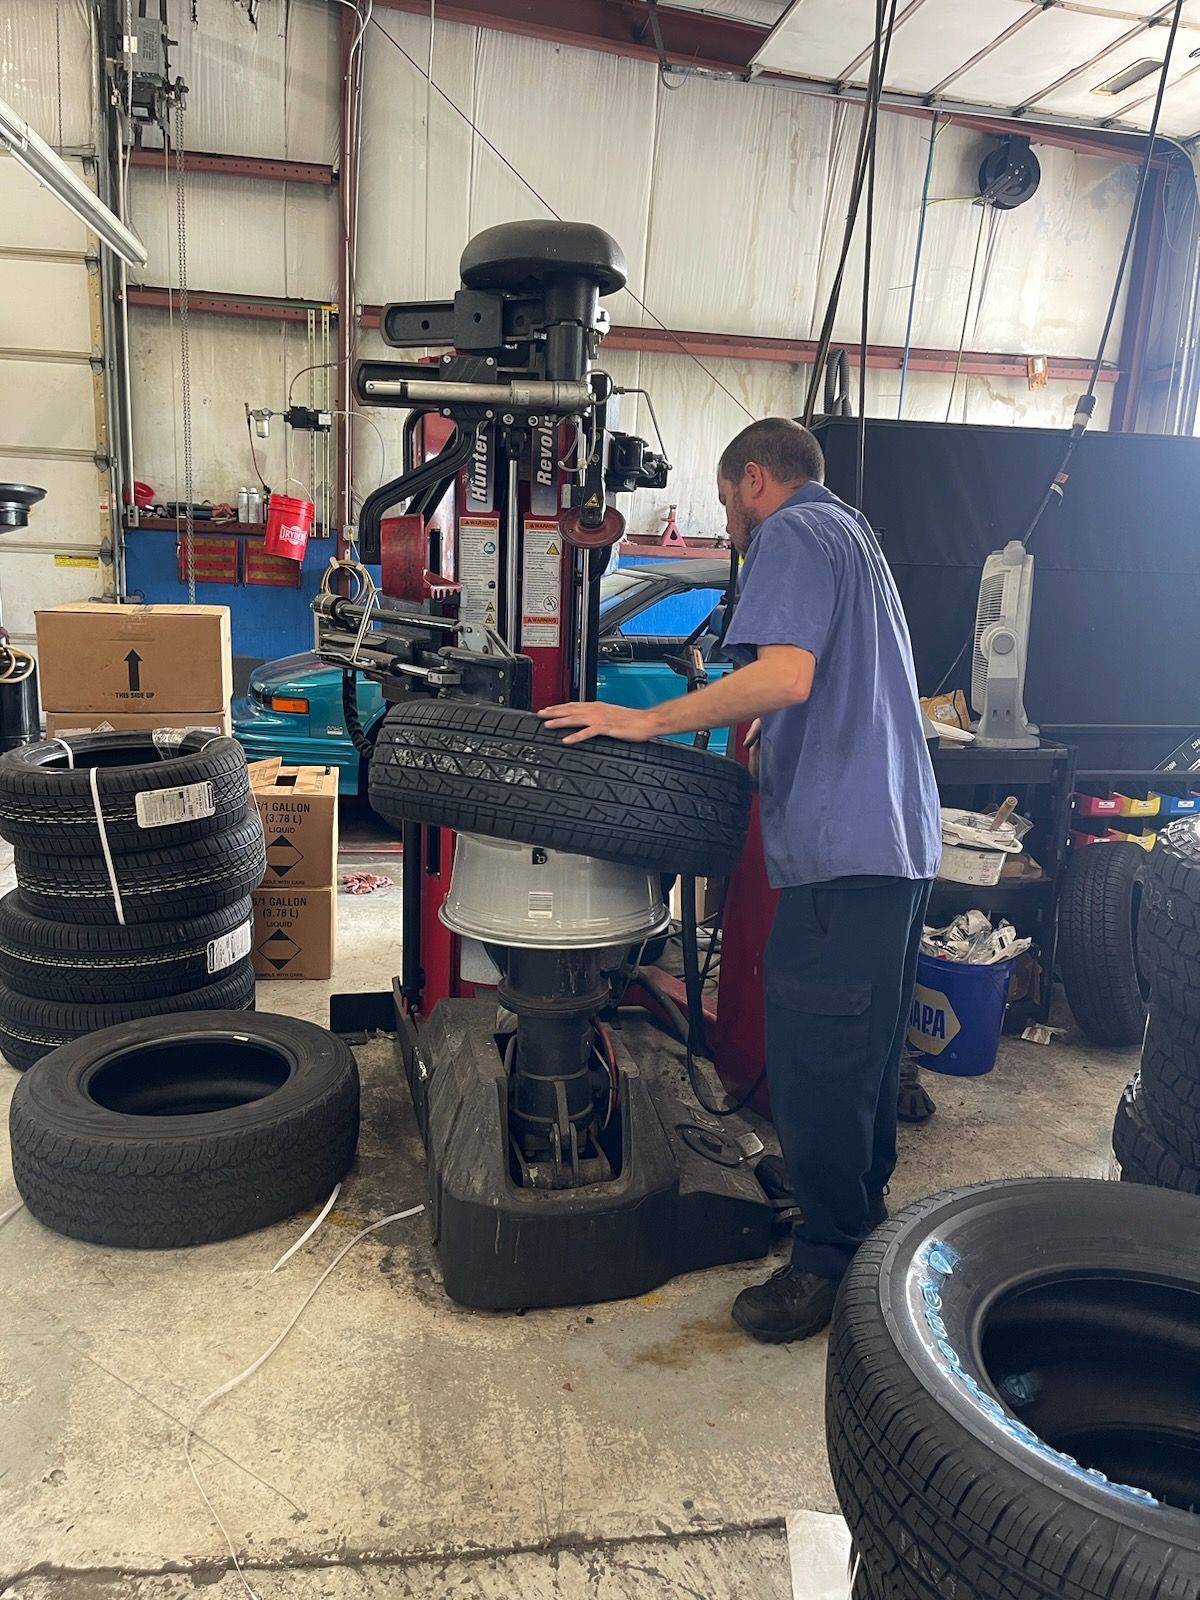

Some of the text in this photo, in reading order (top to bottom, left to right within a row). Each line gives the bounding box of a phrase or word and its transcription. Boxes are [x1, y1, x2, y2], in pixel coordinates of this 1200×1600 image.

[471, 434, 488, 504] Hunter
[272, 802, 310, 813] GALLON
[265, 813, 302, 825] (3.78 L)
[269, 826, 296, 834] LIQUID
[269, 897, 307, 907] GALLON
[263, 908, 299, 919] (3.78 L)
